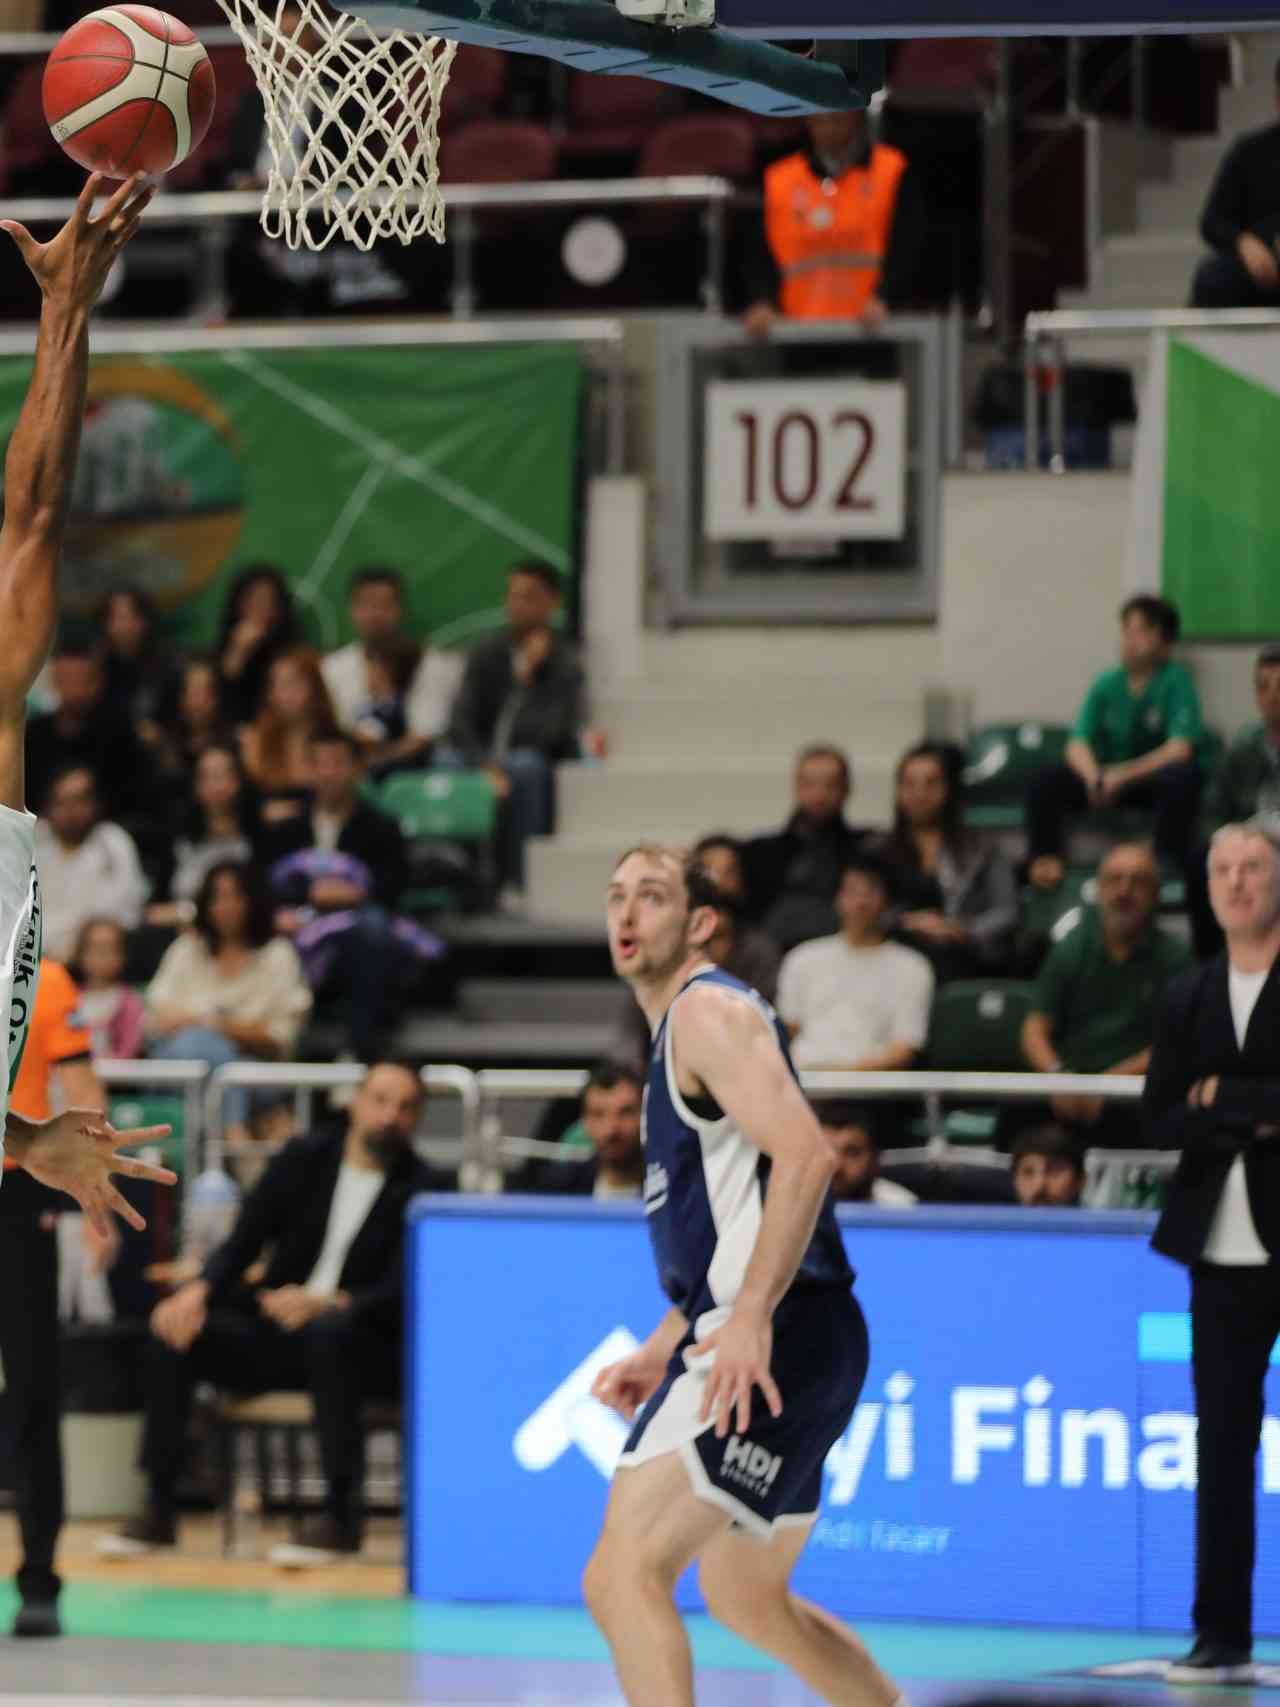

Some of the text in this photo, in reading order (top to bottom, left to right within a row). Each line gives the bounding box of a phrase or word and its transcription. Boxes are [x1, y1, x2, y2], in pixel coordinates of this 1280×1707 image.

[733, 410, 877, 512] 102
[723, 1434, 784, 1484] HDI
[823, 1371, 1280, 1507] yi Fina
